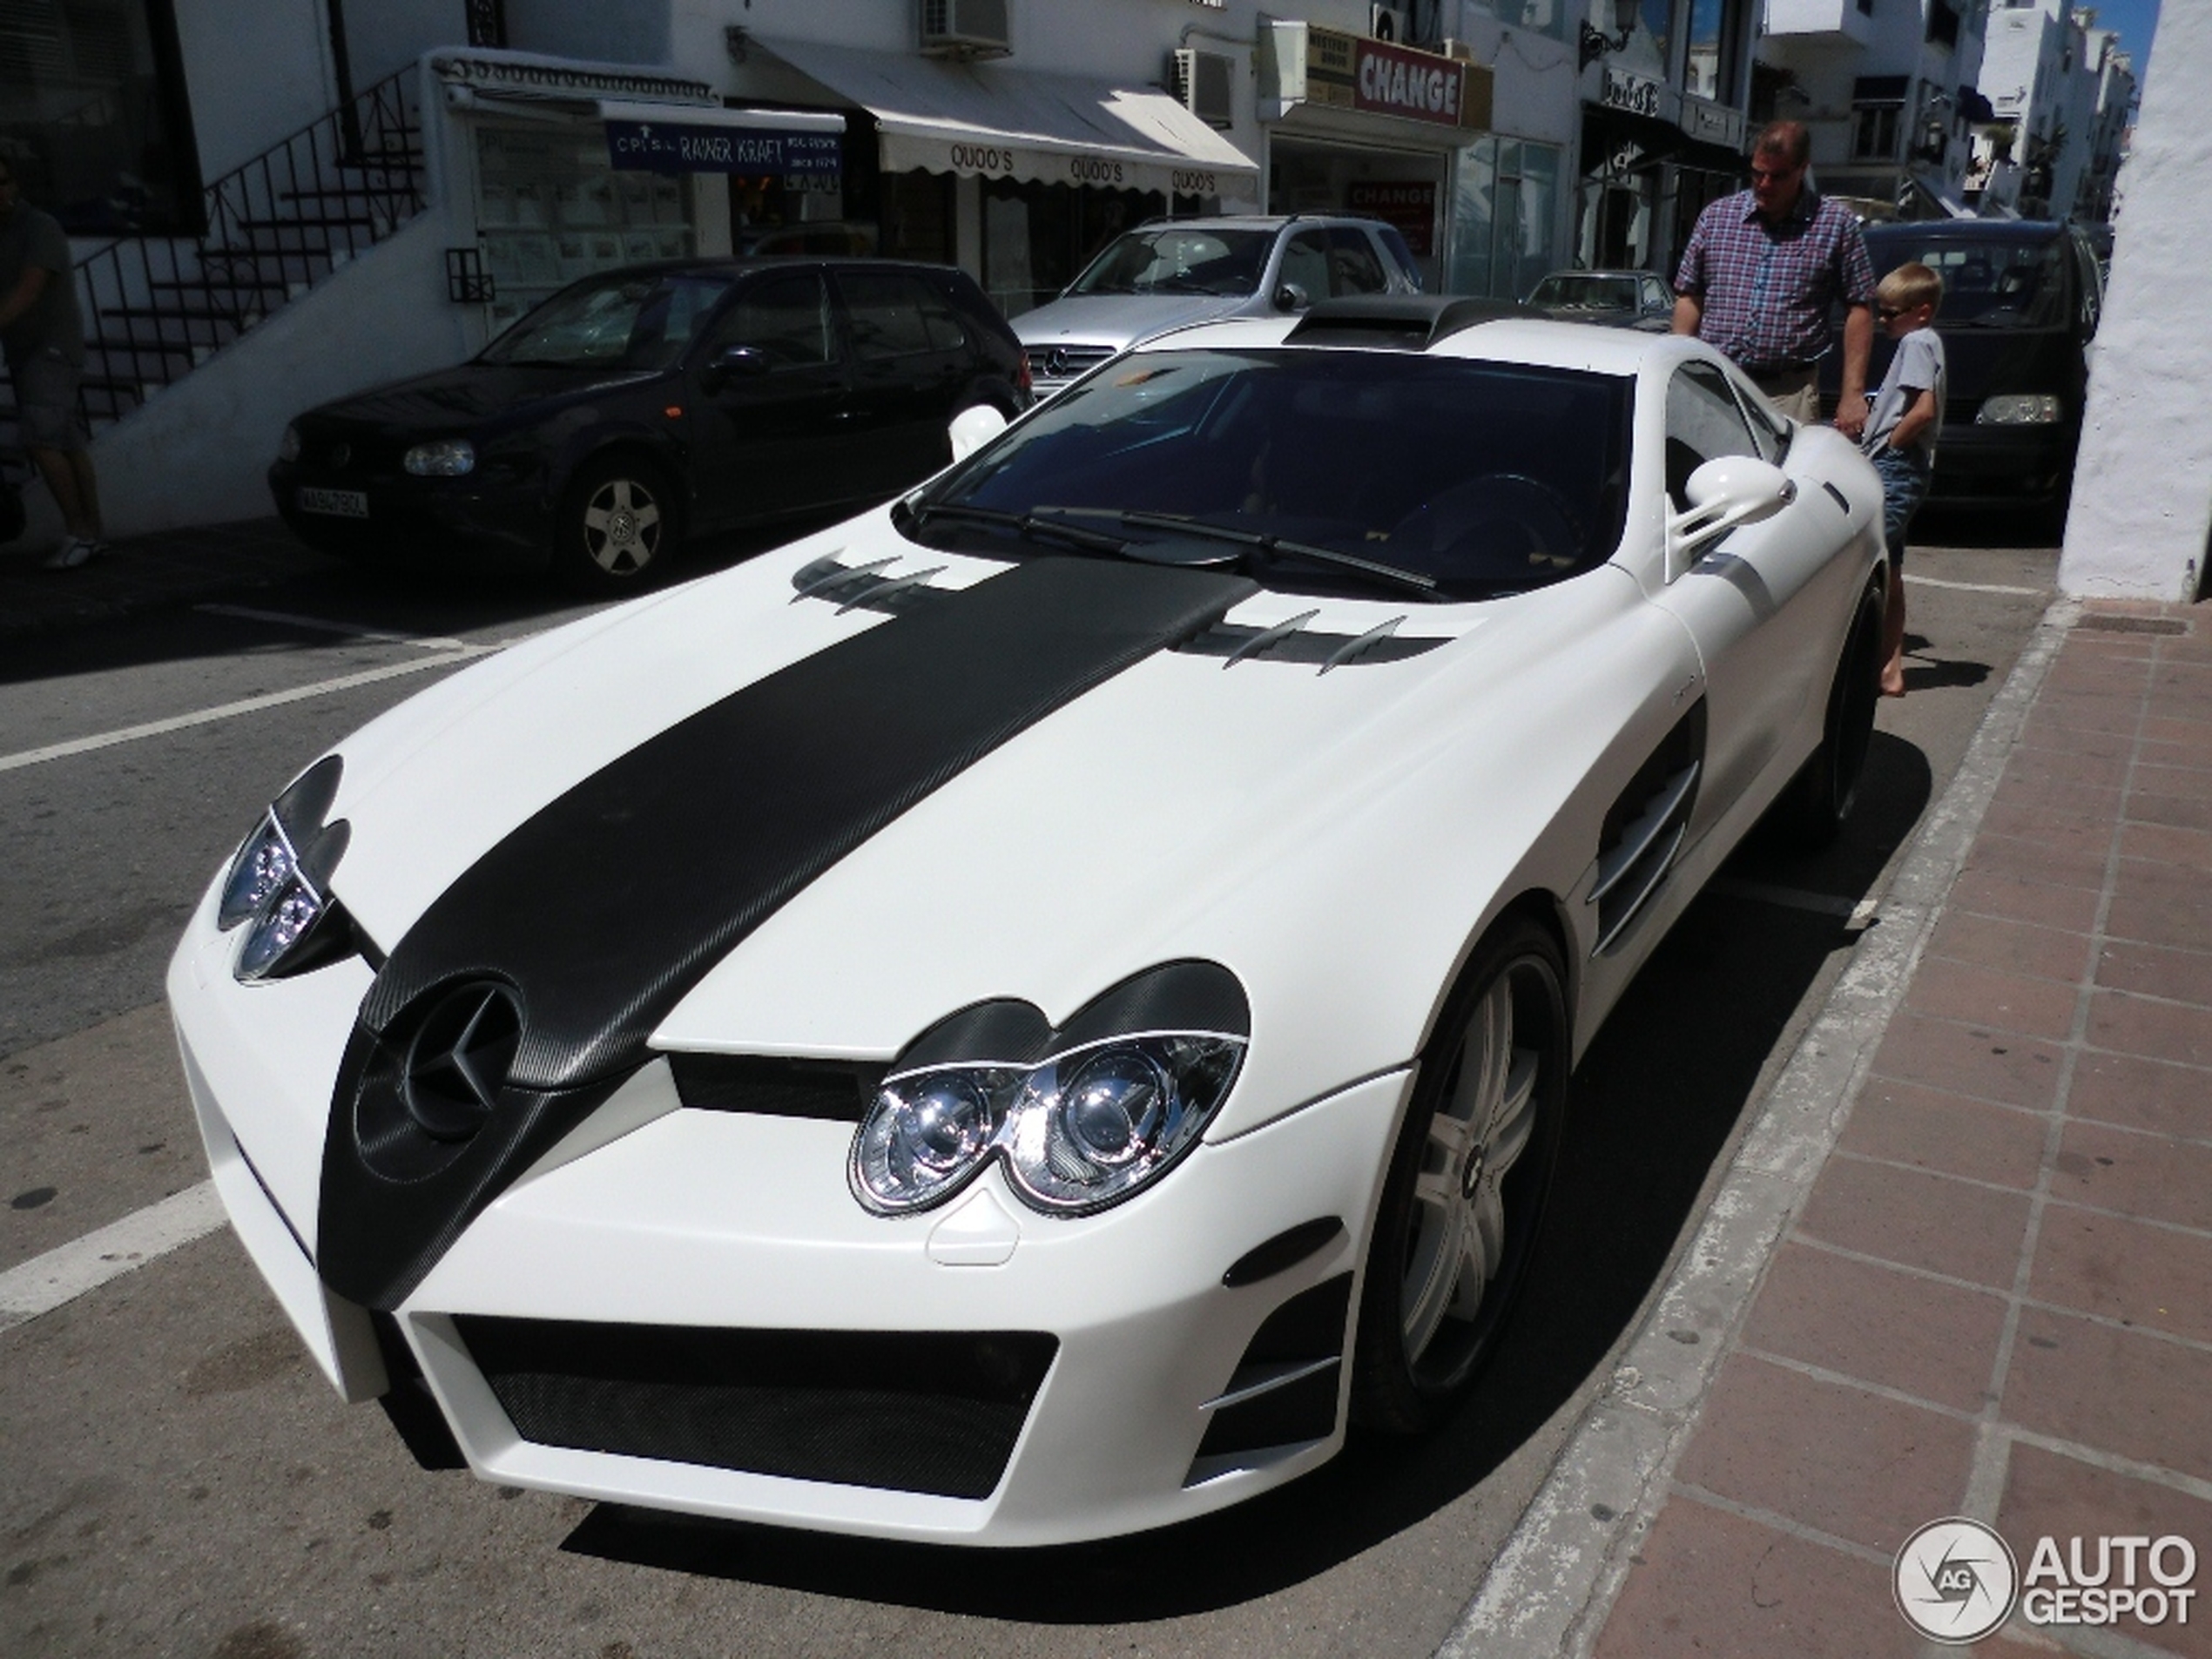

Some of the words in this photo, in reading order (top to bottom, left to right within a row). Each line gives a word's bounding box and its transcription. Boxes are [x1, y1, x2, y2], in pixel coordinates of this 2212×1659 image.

[1359, 53, 1458, 116] CHANGE
[679, 135, 733, 163] RAINER
[736, 138, 783, 165] KRAFT
[951, 144, 1014, 172] QUOO'S
[1070, 158, 1123, 183] QUOO'S
[1171, 170, 1216, 192] QUOO'S
[1352, 187, 1433, 205] CHANGE
